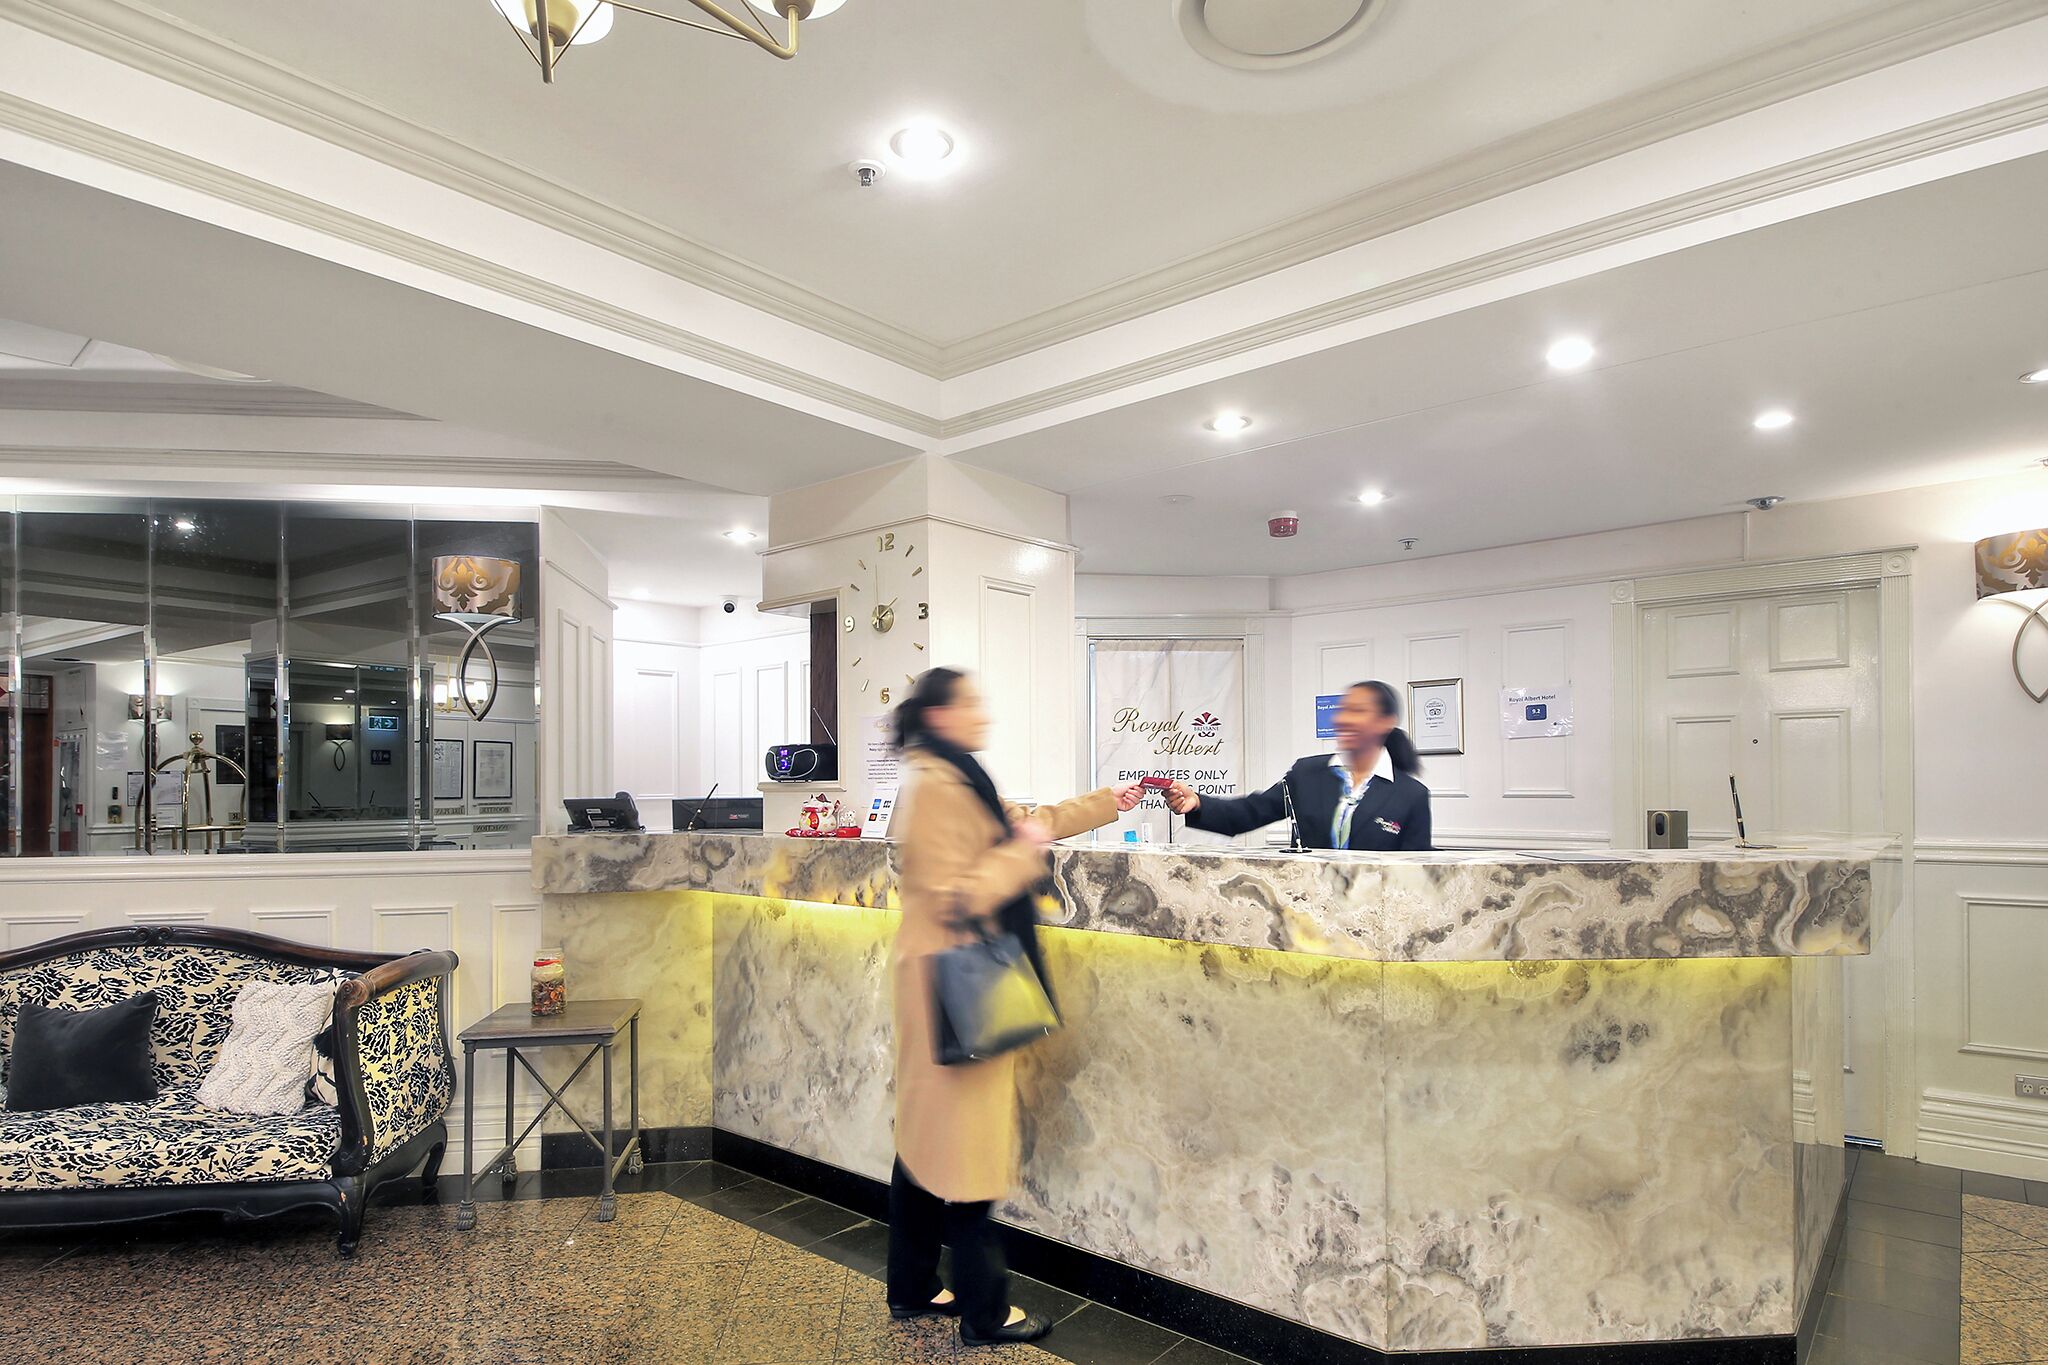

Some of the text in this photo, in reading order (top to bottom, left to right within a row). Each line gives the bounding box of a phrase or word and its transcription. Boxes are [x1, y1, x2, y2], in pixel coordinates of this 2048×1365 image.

[877, 533, 895, 552] 12
[918, 603, 929, 620] 3
[844, 615, 855, 633] 9
[880, 687, 889, 704] 6
[1112, 707, 1184, 742] Royal
[1154, 731, 1224, 755] Albert
[1194, 769, 1228, 780] ONLY
[1198, 784, 1236, 794] POINT
[1140, 799, 1170, 809] THAN
